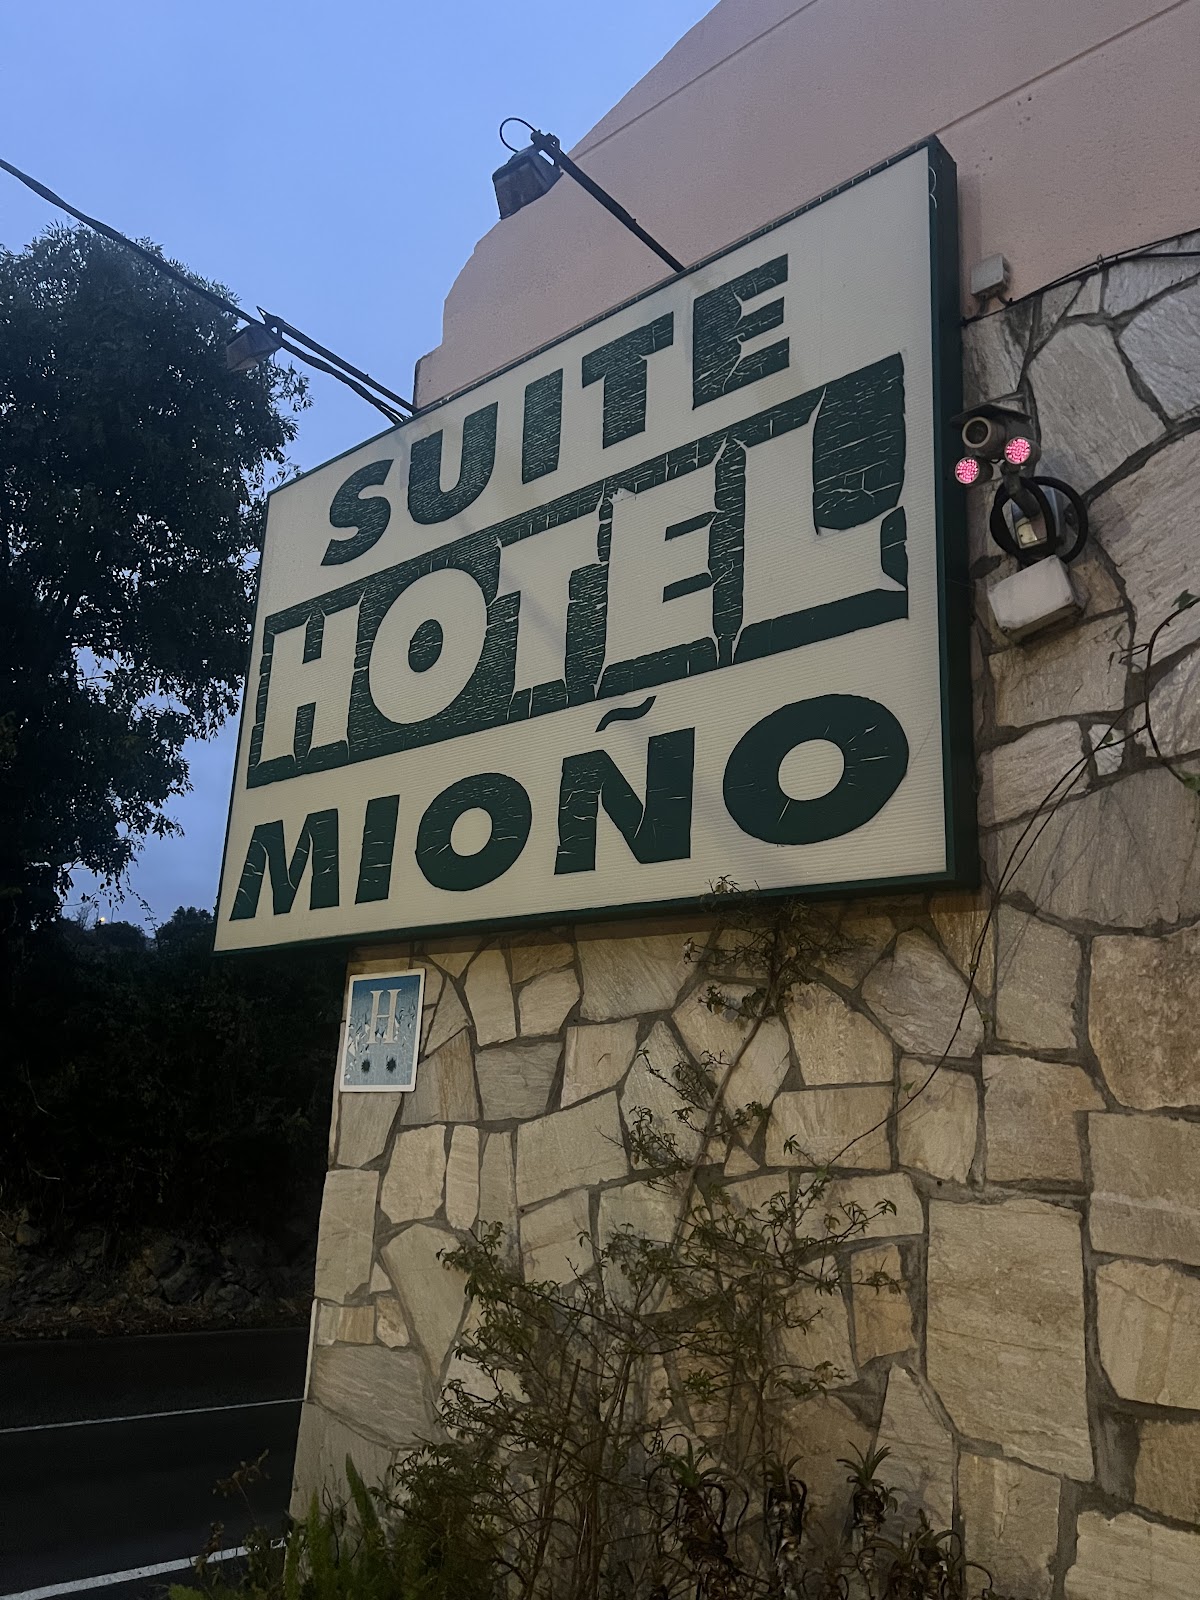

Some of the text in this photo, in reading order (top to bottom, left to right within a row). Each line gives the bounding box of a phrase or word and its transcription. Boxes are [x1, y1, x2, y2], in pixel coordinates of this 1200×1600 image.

[320, 253, 790, 566] SUITE
[256, 418, 906, 766] HOTEL
[229, 693, 910, 922] MIOÑO
[366, 988, 402, 1044] H
